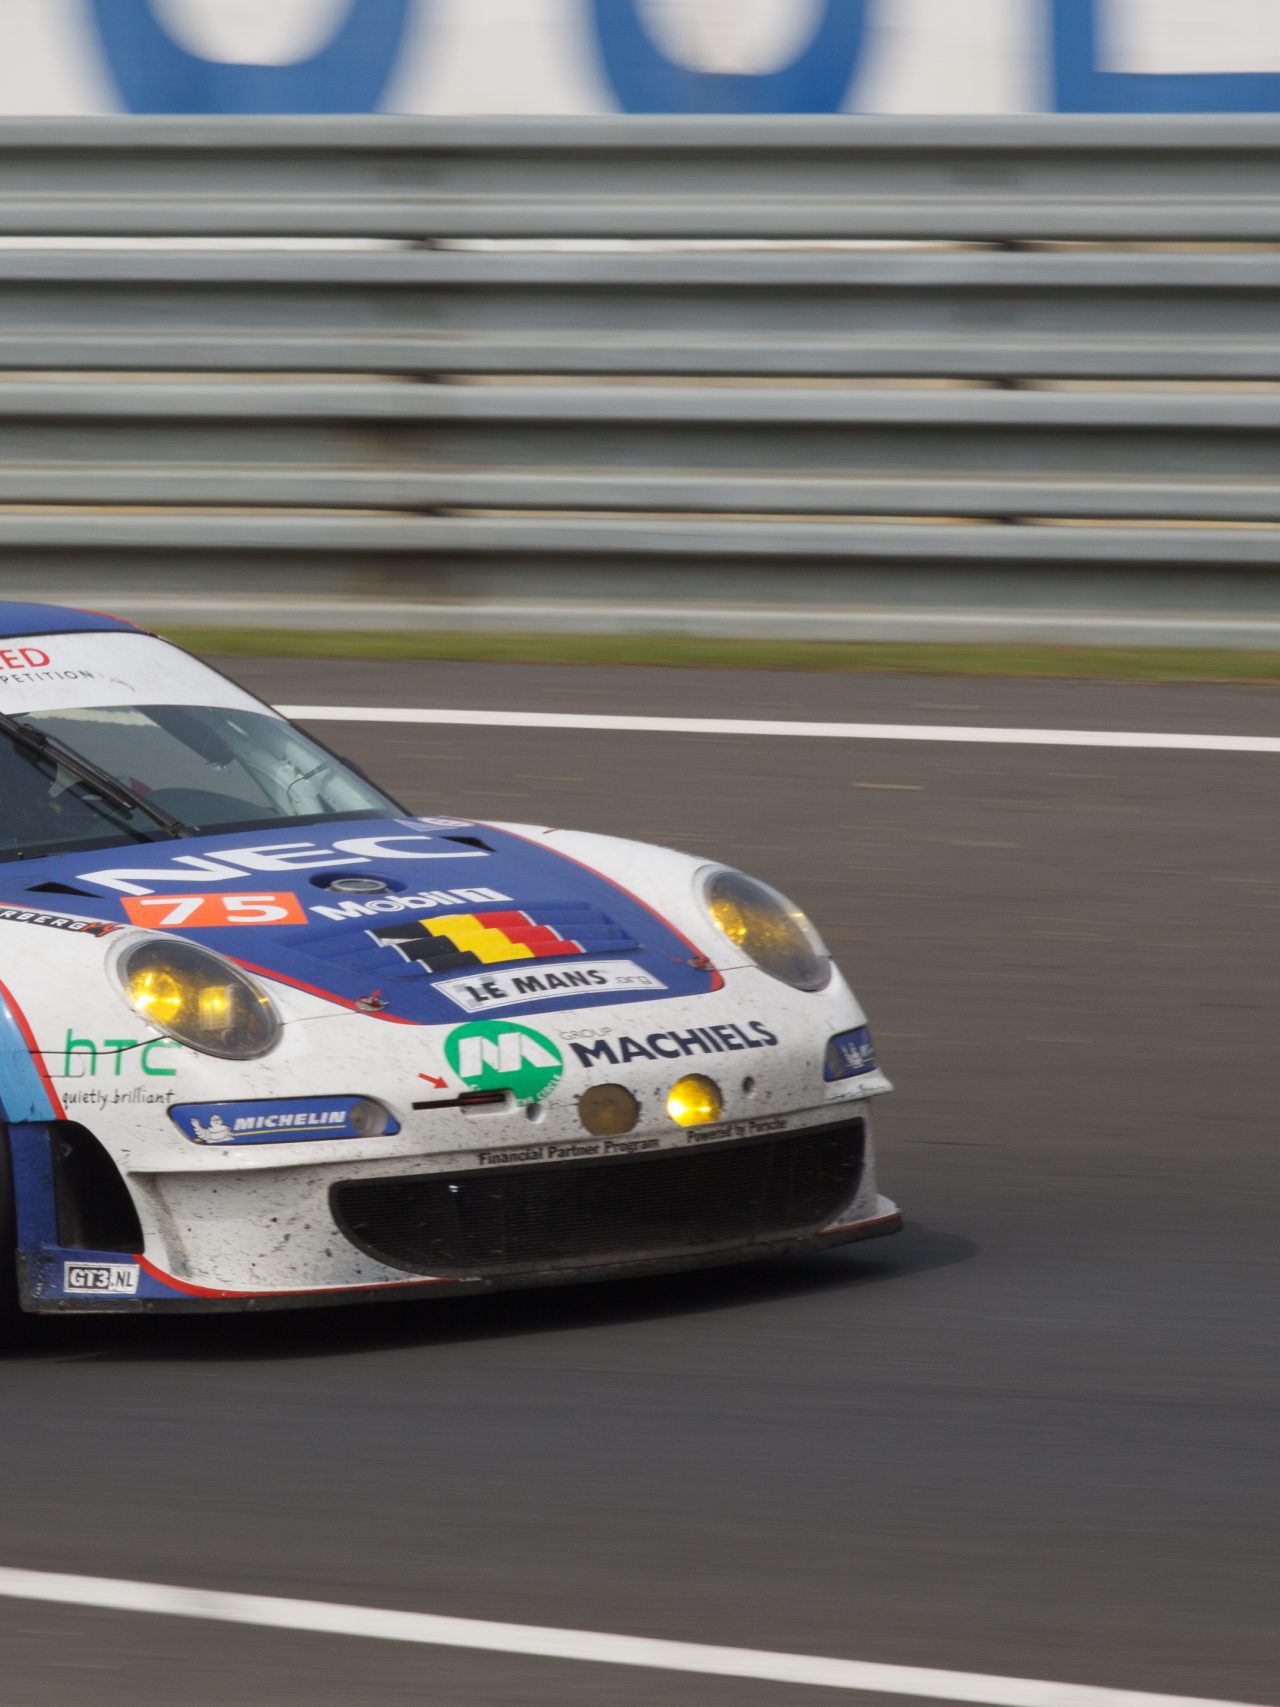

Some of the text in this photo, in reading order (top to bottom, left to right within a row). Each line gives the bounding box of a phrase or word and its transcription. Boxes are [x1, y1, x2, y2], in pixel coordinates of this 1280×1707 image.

[75, 836, 491, 896] NEC
[138, 895, 289, 925] 75
[465, 981, 507, 1003] LE
[511, 969, 608, 994] MANS
[559, 1026, 613, 1041] GROUP
[569, 1020, 778, 1067] MACHIELS
[62, 1085, 176, 1111] quietly brilliant
[233, 1111, 347, 1131] MICHELIN
[478, 1147, 544, 1165] Financial
[548, 1145, 601, 1160] Partner
[69, 1268, 134, 1288] GT3.NL
